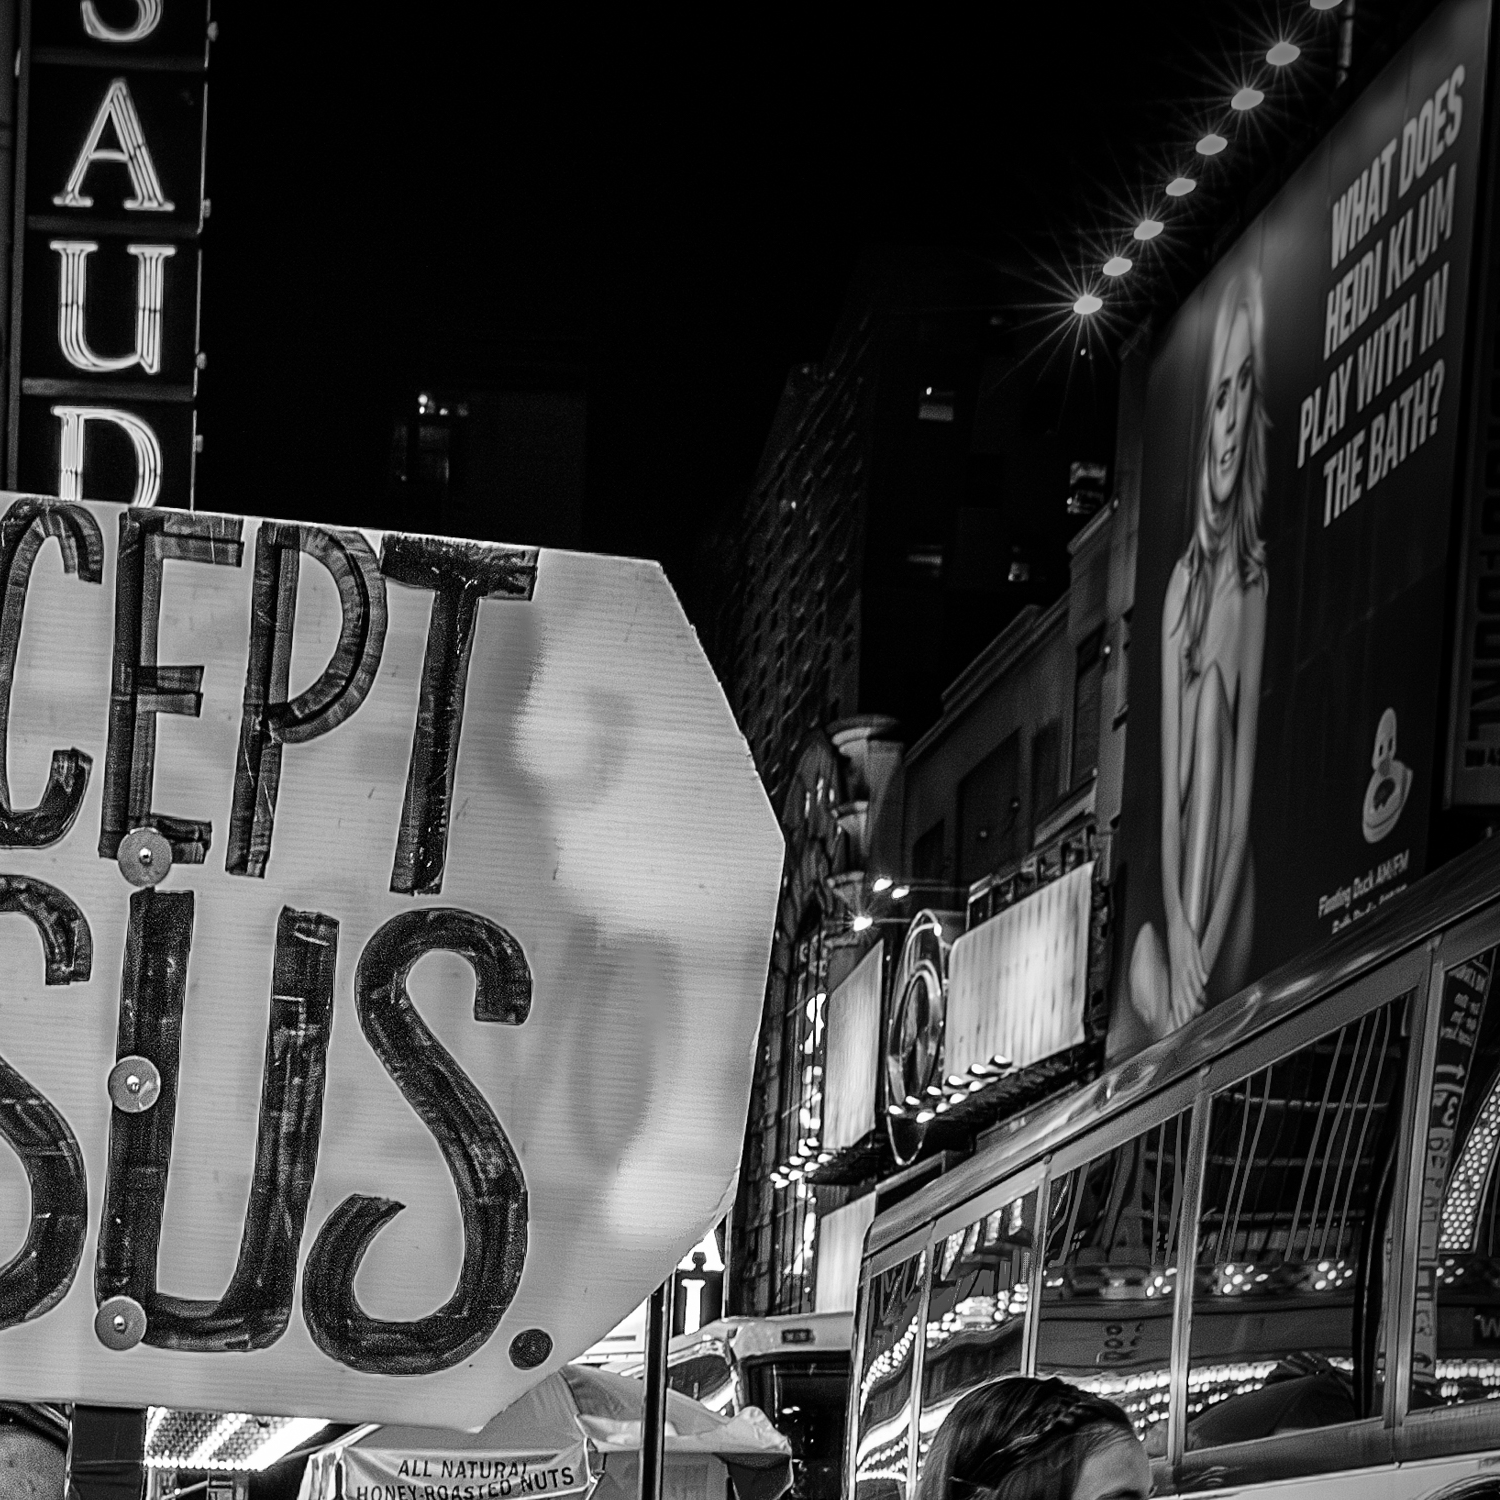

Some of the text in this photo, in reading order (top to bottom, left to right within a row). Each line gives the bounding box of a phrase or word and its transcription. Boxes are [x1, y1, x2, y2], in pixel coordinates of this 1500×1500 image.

[1331, 64, 1466, 271] WHAT DOES
[1324, 162, 1457, 361] HEIDI KLUM
[1297, 261, 1450, 468] PLAY WITH IN
[1324, 358, 1445, 527] THE BATH?
[398, 1459, 432, 1477] ALL
[520, 1467, 575, 1491] NUTS
